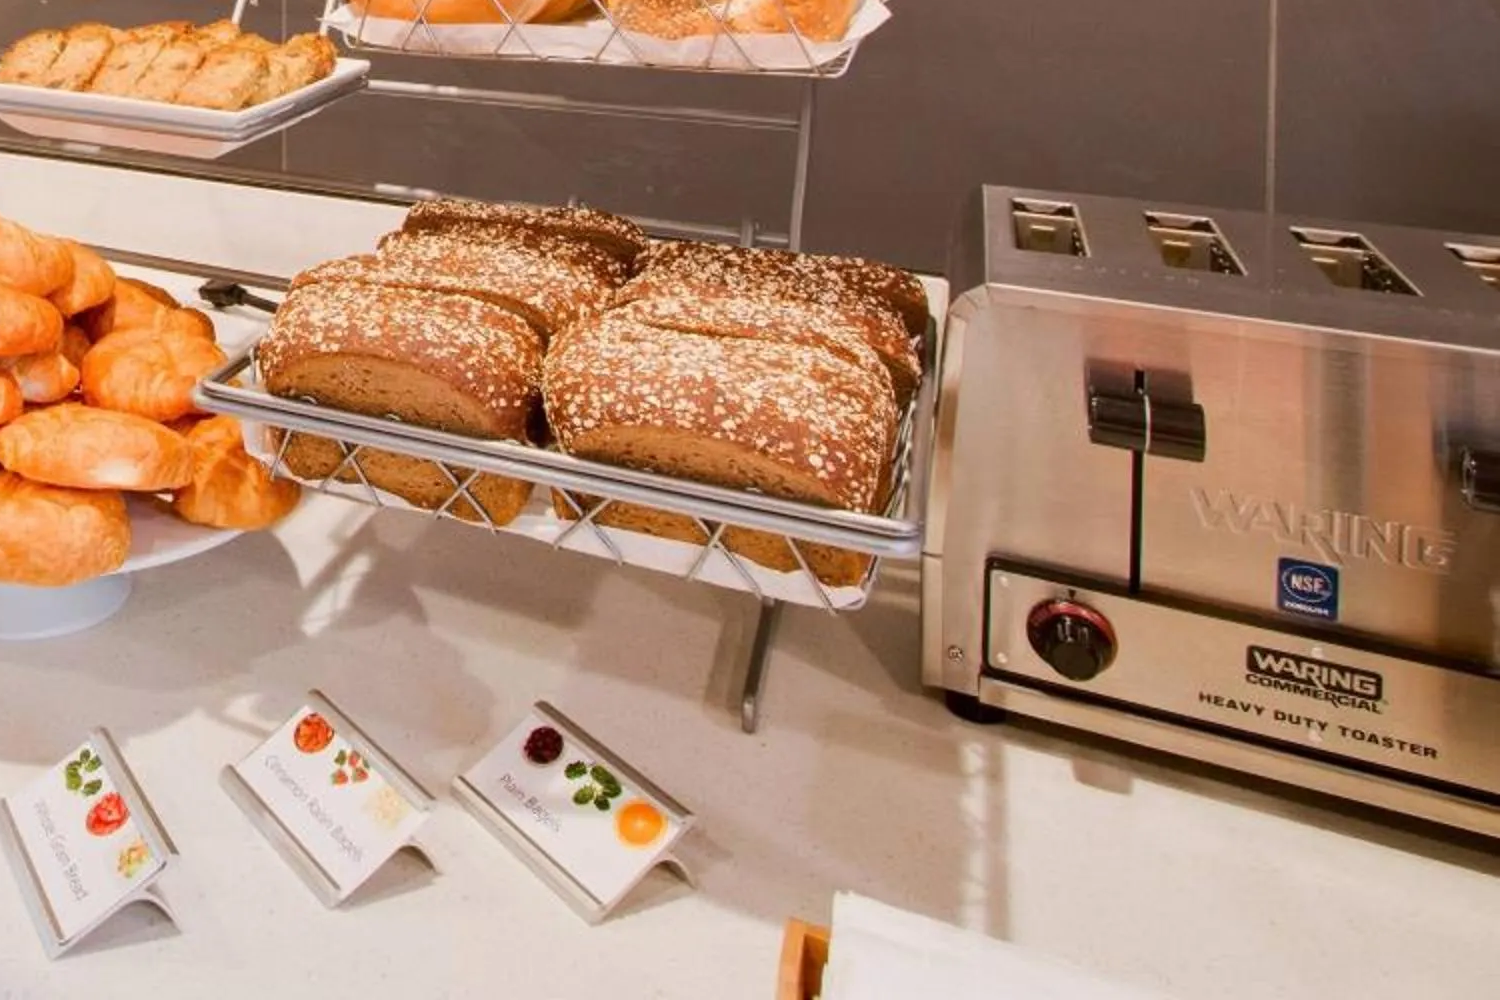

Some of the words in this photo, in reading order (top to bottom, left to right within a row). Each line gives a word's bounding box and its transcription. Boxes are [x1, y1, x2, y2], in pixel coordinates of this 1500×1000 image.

[1189, 486, 1456, 572] WARING
[1291, 573, 1325, 594] NSF
[1245, 673, 1382, 715] COMMERCIAL
[1252, 649, 1378, 699] WARING
[1198, 690, 1267, 717] HEAVY
[1273, 709, 1329, 733] DUTY
[1338, 725, 1439, 760] TOASTER
